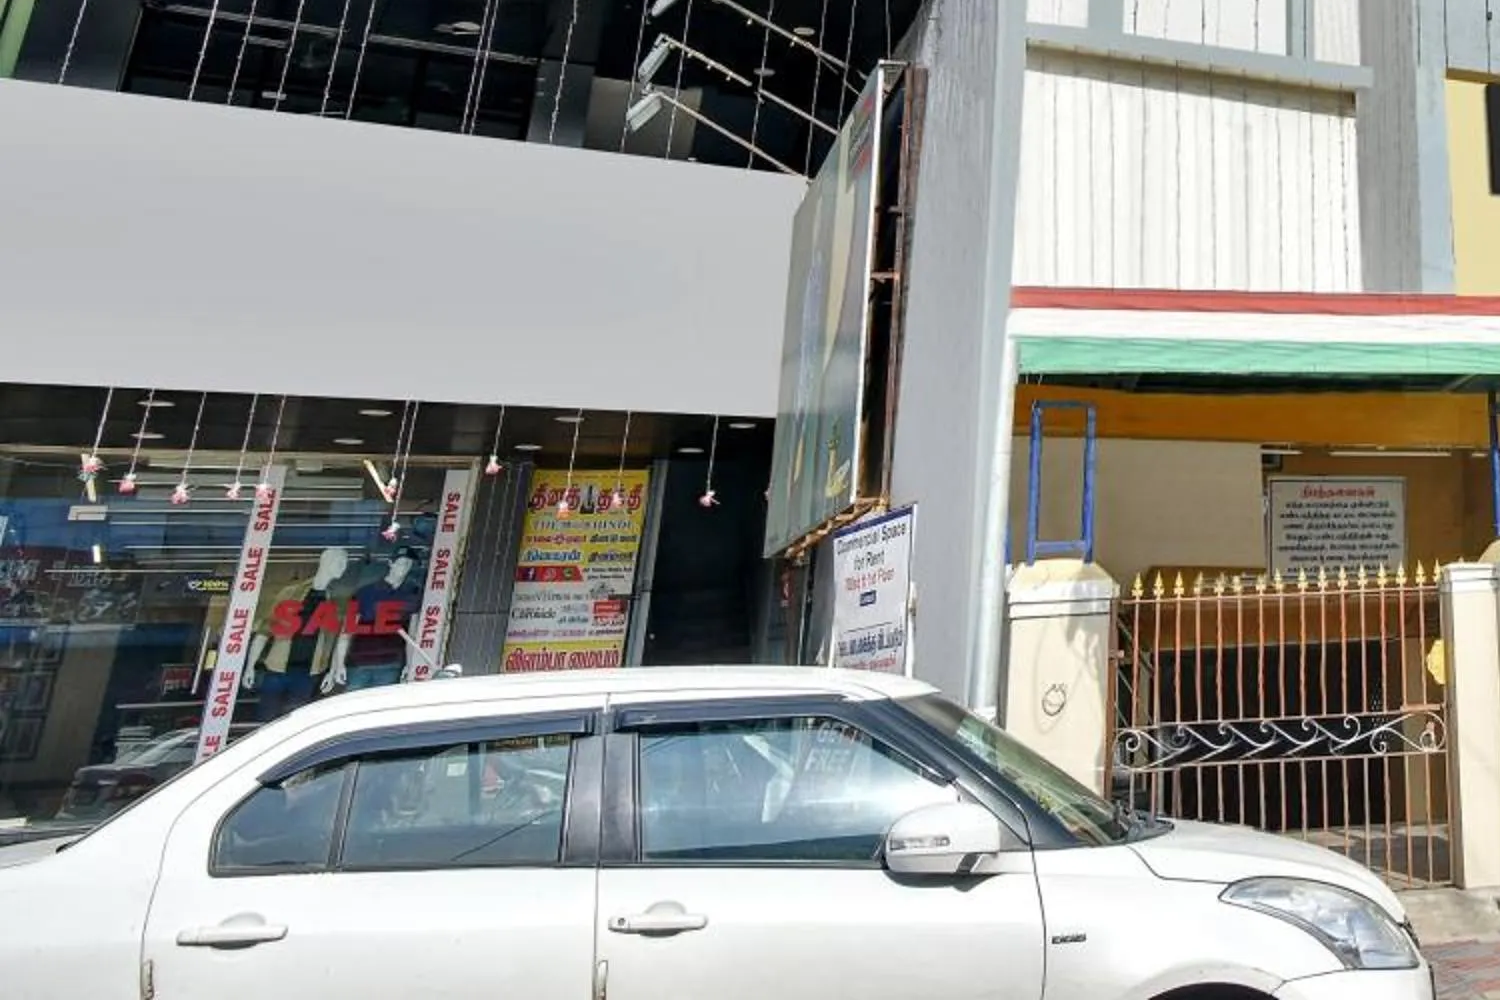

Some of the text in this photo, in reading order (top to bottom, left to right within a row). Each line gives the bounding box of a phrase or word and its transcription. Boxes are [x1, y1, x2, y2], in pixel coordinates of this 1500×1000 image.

[442, 491, 461, 533] SALE
[881, 522, 906, 544] Space
[240, 547, 263, 592] SALE
[431, 548, 450, 591] SALE
[866, 551, 885, 568] Rent
[226, 608, 249, 654] SALE
[269, 599, 407, 637] SALE
[419, 604, 441, 650] SALE
[212, 670, 235, 717] SALE
[202, 735, 221, 757] LE
